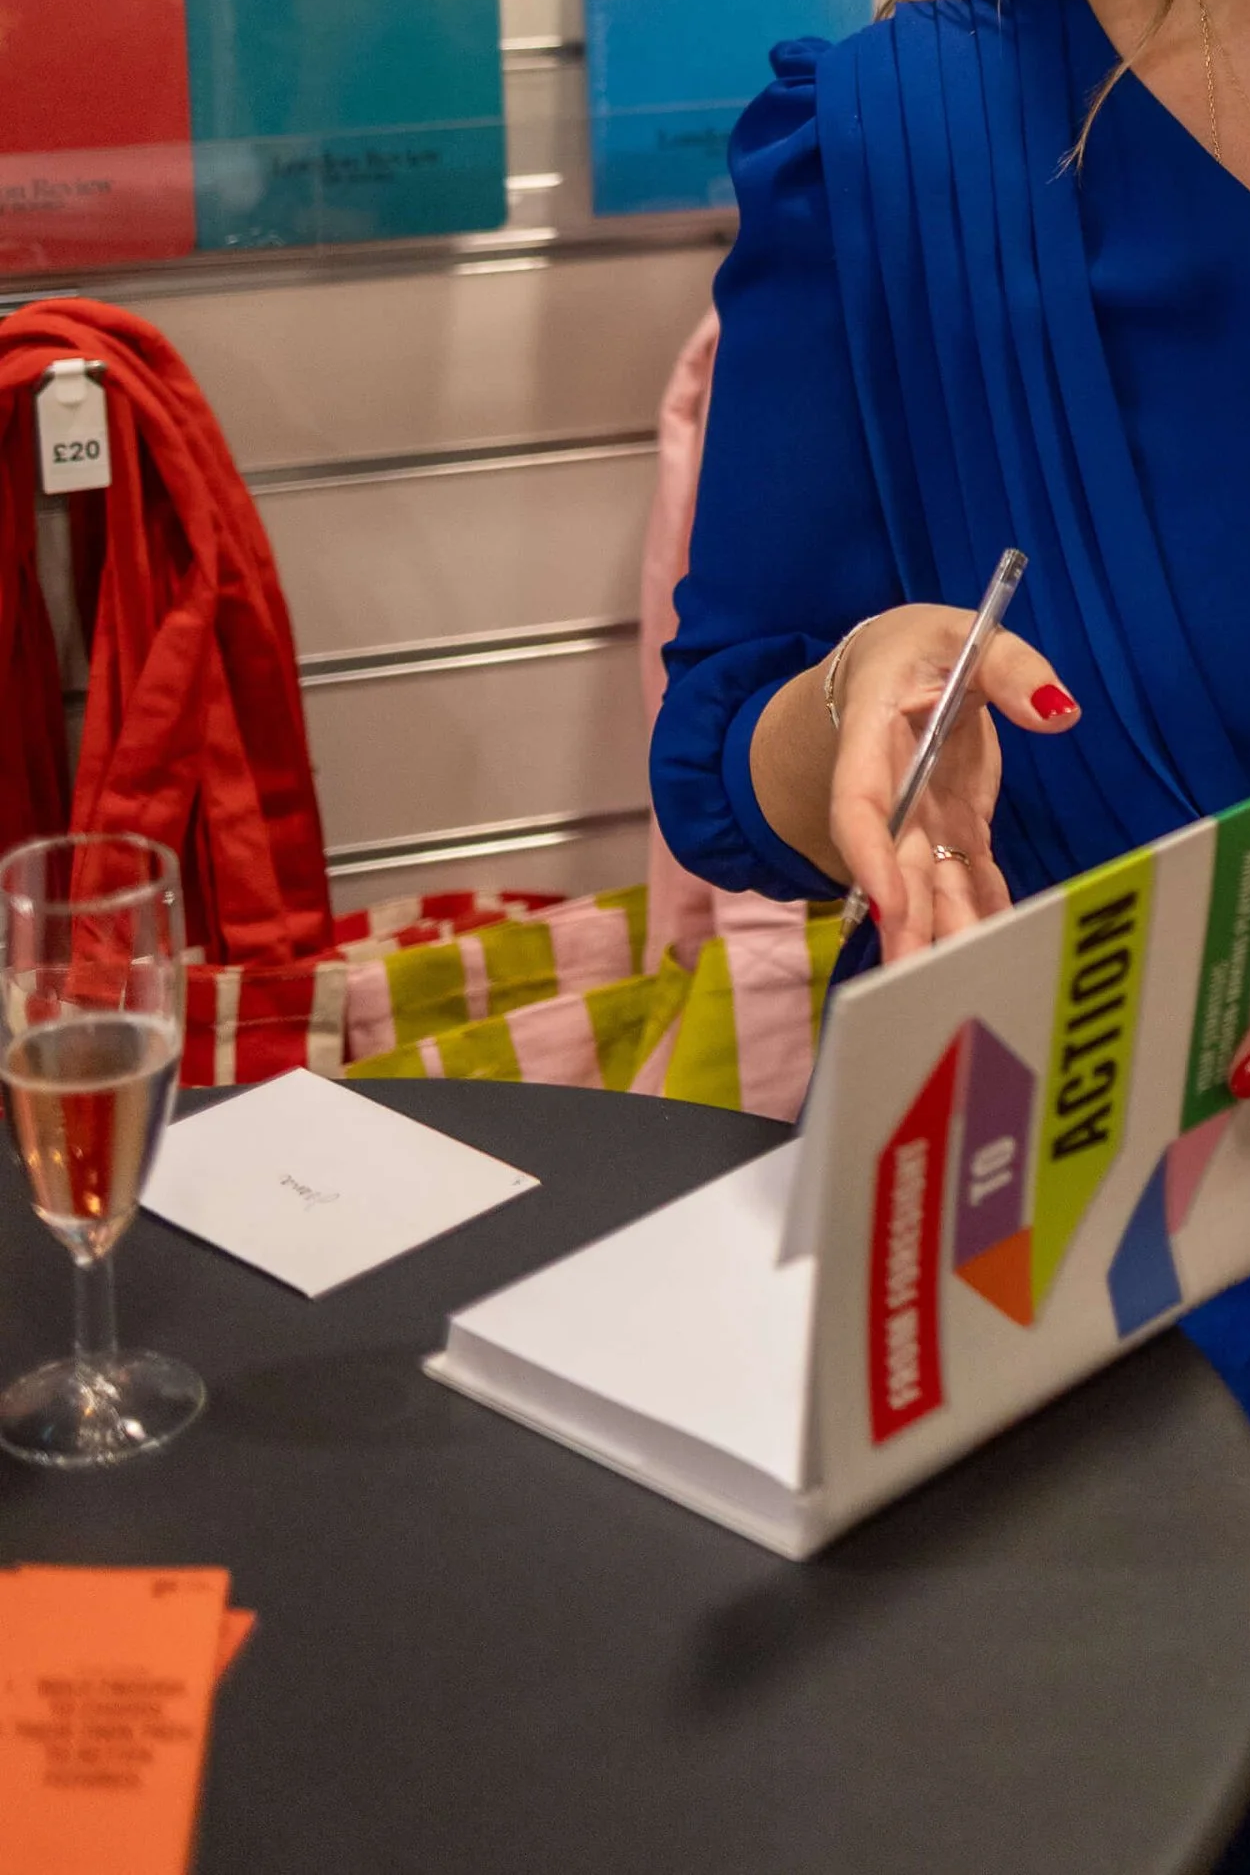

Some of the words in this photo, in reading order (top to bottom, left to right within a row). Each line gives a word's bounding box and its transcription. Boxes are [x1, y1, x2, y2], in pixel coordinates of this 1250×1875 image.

[52, 438, 101, 464] £20
[1051, 891, 1138, 1162] ACTION
[968, 1133, 1016, 1208] TO
